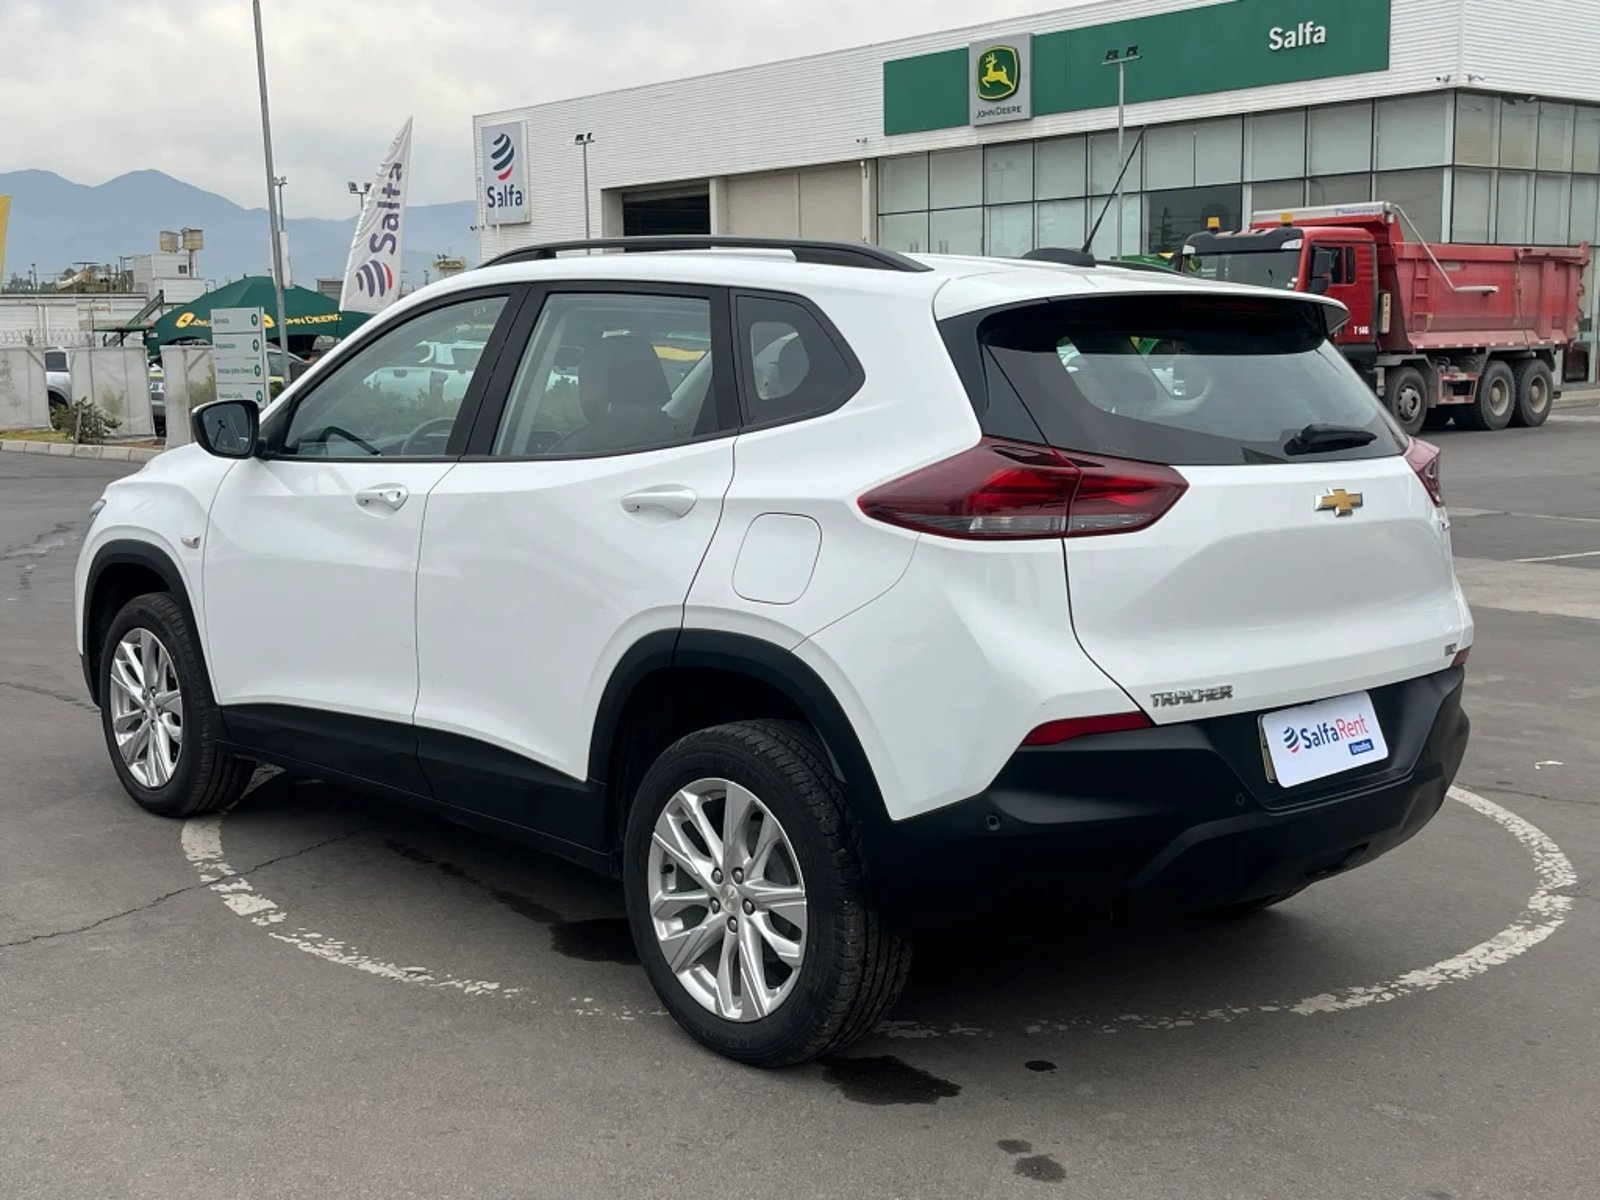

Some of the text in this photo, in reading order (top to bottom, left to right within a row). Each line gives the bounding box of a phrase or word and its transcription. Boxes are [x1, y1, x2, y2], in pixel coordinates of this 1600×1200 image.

[1268, 21, 1326, 51] Salfa
[369, 163, 402, 255] Salfa
[487, 184, 523, 208] Salfa
[1150, 685, 1233, 708] TRACKER
[1300, 714, 1369, 749] SalfaRent
